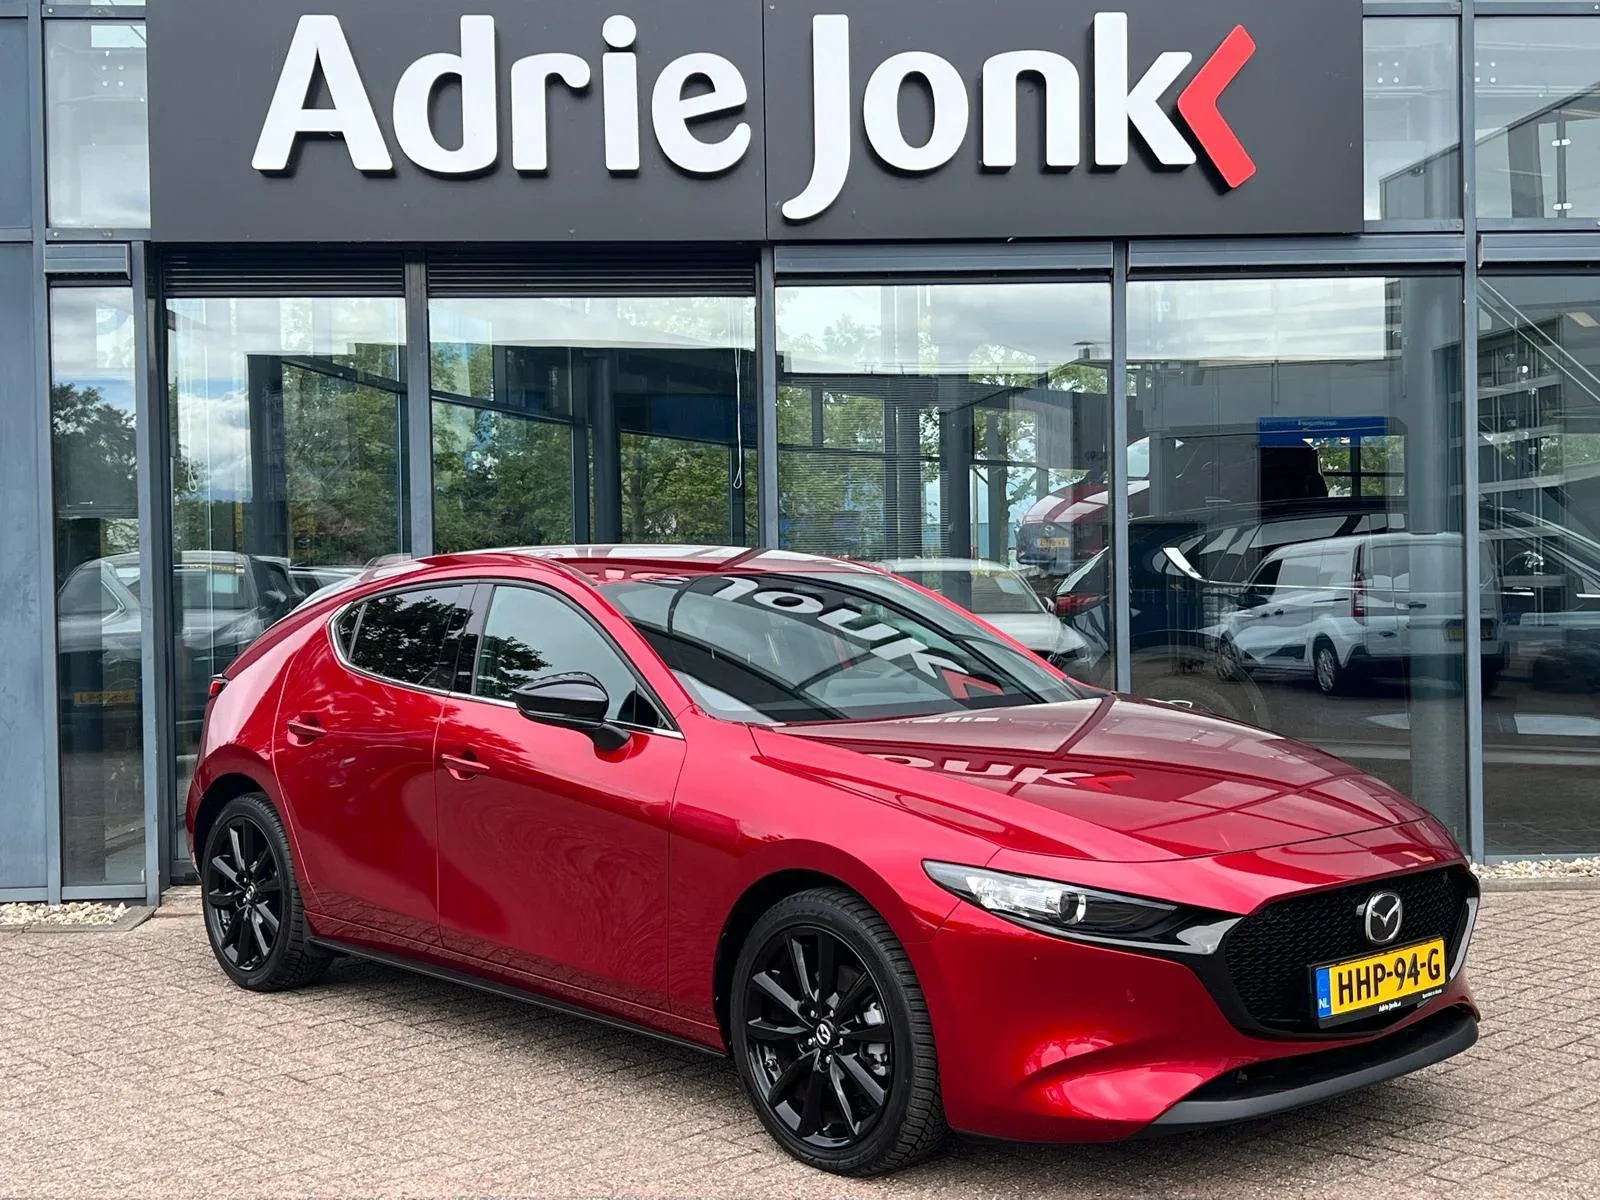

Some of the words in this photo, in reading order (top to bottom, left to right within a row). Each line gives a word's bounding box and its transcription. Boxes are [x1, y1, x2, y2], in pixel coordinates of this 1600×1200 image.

[251, 14, 752, 174] Adrie
[781, 11, 1197, 220] Jonk
[1318, 998, 1330, 1009] NL
[1338, 948, 1441, 1005] HHP-94-G
